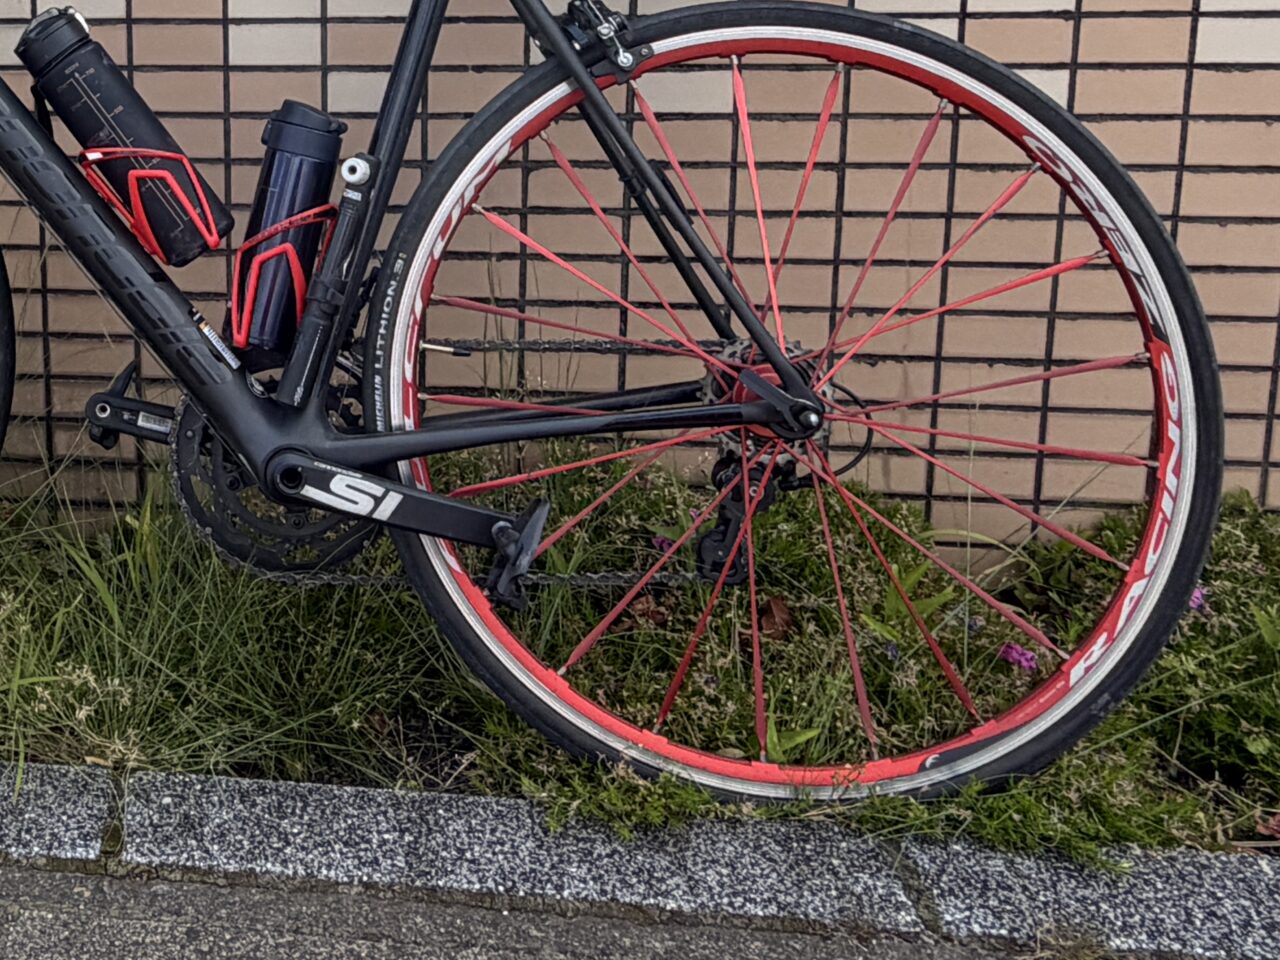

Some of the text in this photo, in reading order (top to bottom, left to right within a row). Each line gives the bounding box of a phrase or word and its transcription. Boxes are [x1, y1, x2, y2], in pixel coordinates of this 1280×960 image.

[374, 376, 385, 433] MICHELIN
[1022, 135, 1180, 688] RACING ZERO
